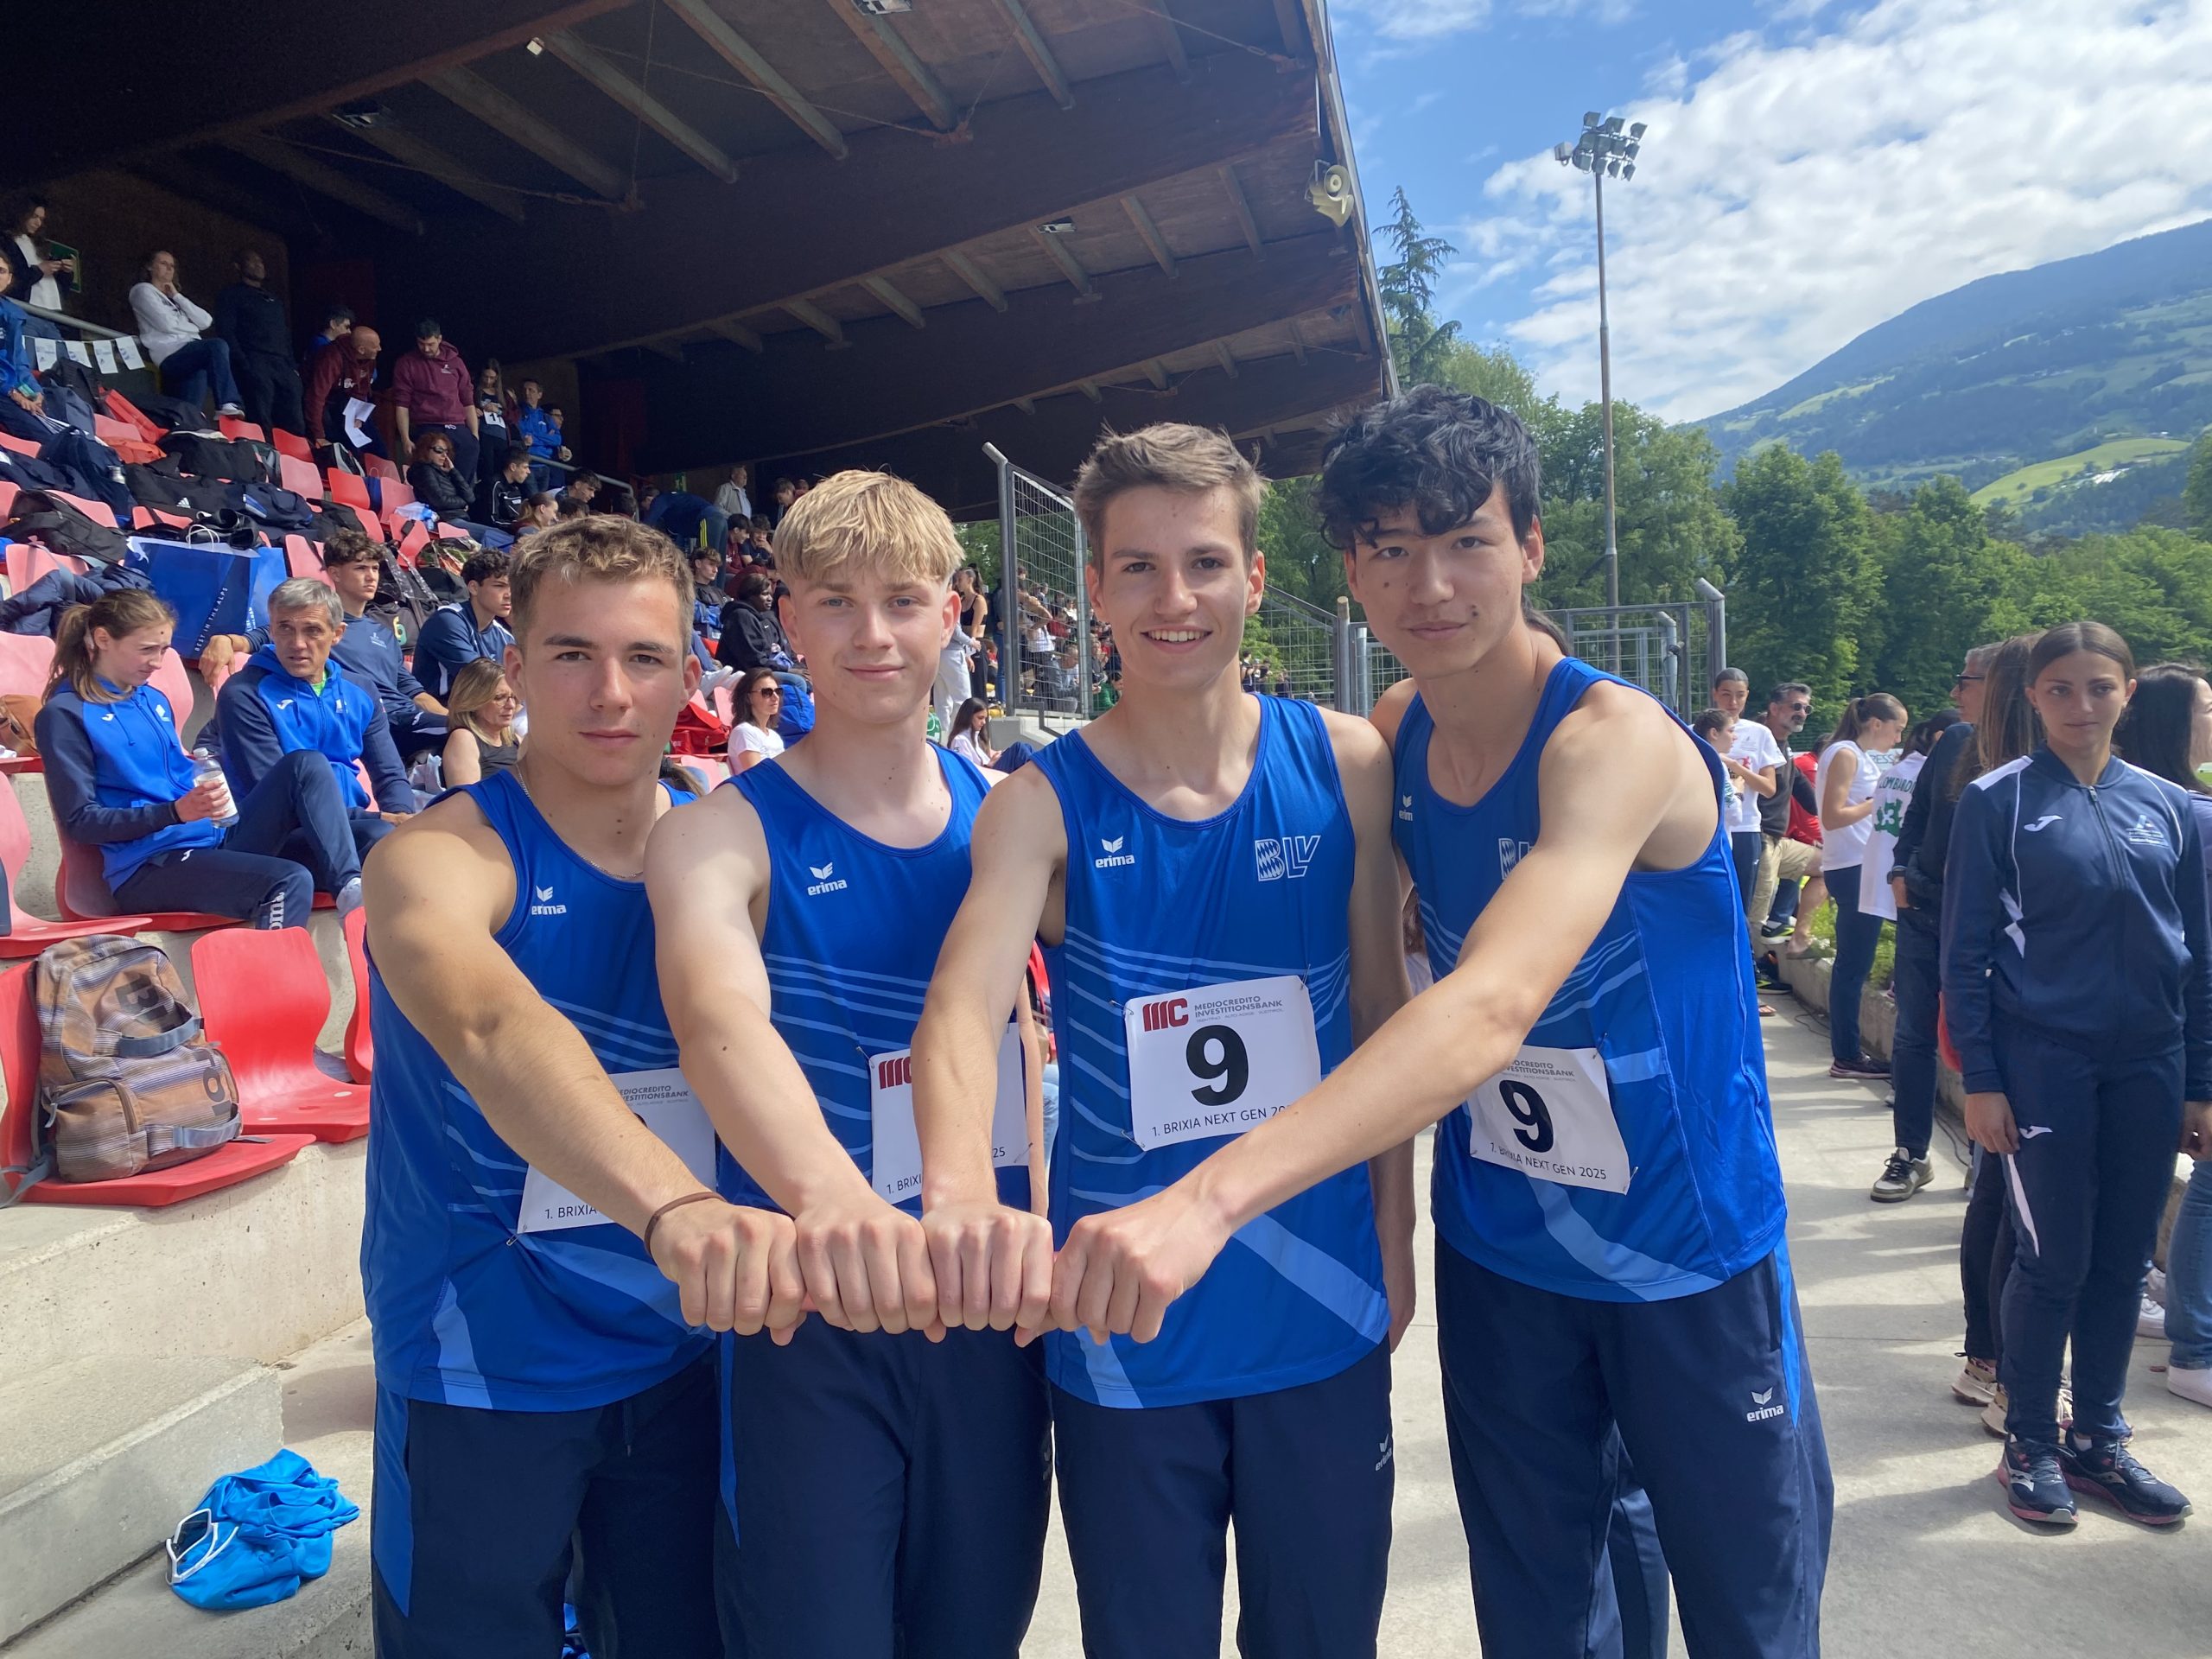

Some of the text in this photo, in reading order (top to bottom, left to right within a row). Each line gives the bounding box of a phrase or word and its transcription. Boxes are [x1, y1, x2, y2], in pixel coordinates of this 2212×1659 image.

[217, 587, 228, 605] ALPS
[1095, 854, 1135, 868] erima
[1255, 835, 1321, 882] BLV
[807, 879, 848, 896] erima
[1194, 995, 1261, 1010] MEDIOCREDITO
[1194, 1000, 1283, 1018] INVESTITIONSBANK
[1185, 1024, 1249, 1107] 9
[617, 1085, 671, 1096] EDIOCREDITO
[1151, 1126, 1160, 1137] 1.
[1163, 1119, 1201, 1135] BRIXIA
[1205, 1112, 1236, 1127] NEXT
[1240, 1108, 1267, 1121] GEN
[1499, 1079, 1554, 1154] 9
[1525, 1156, 1550, 1171] NEXT
[1552, 1164, 1576, 1176] GEN
[1580, 1166, 1607, 1180] 2025
[886, 1184, 894, 1194] 1.
[544, 1205, 597, 1219] 1. BRIXIA
[1747, 1402, 1785, 1422] erima
